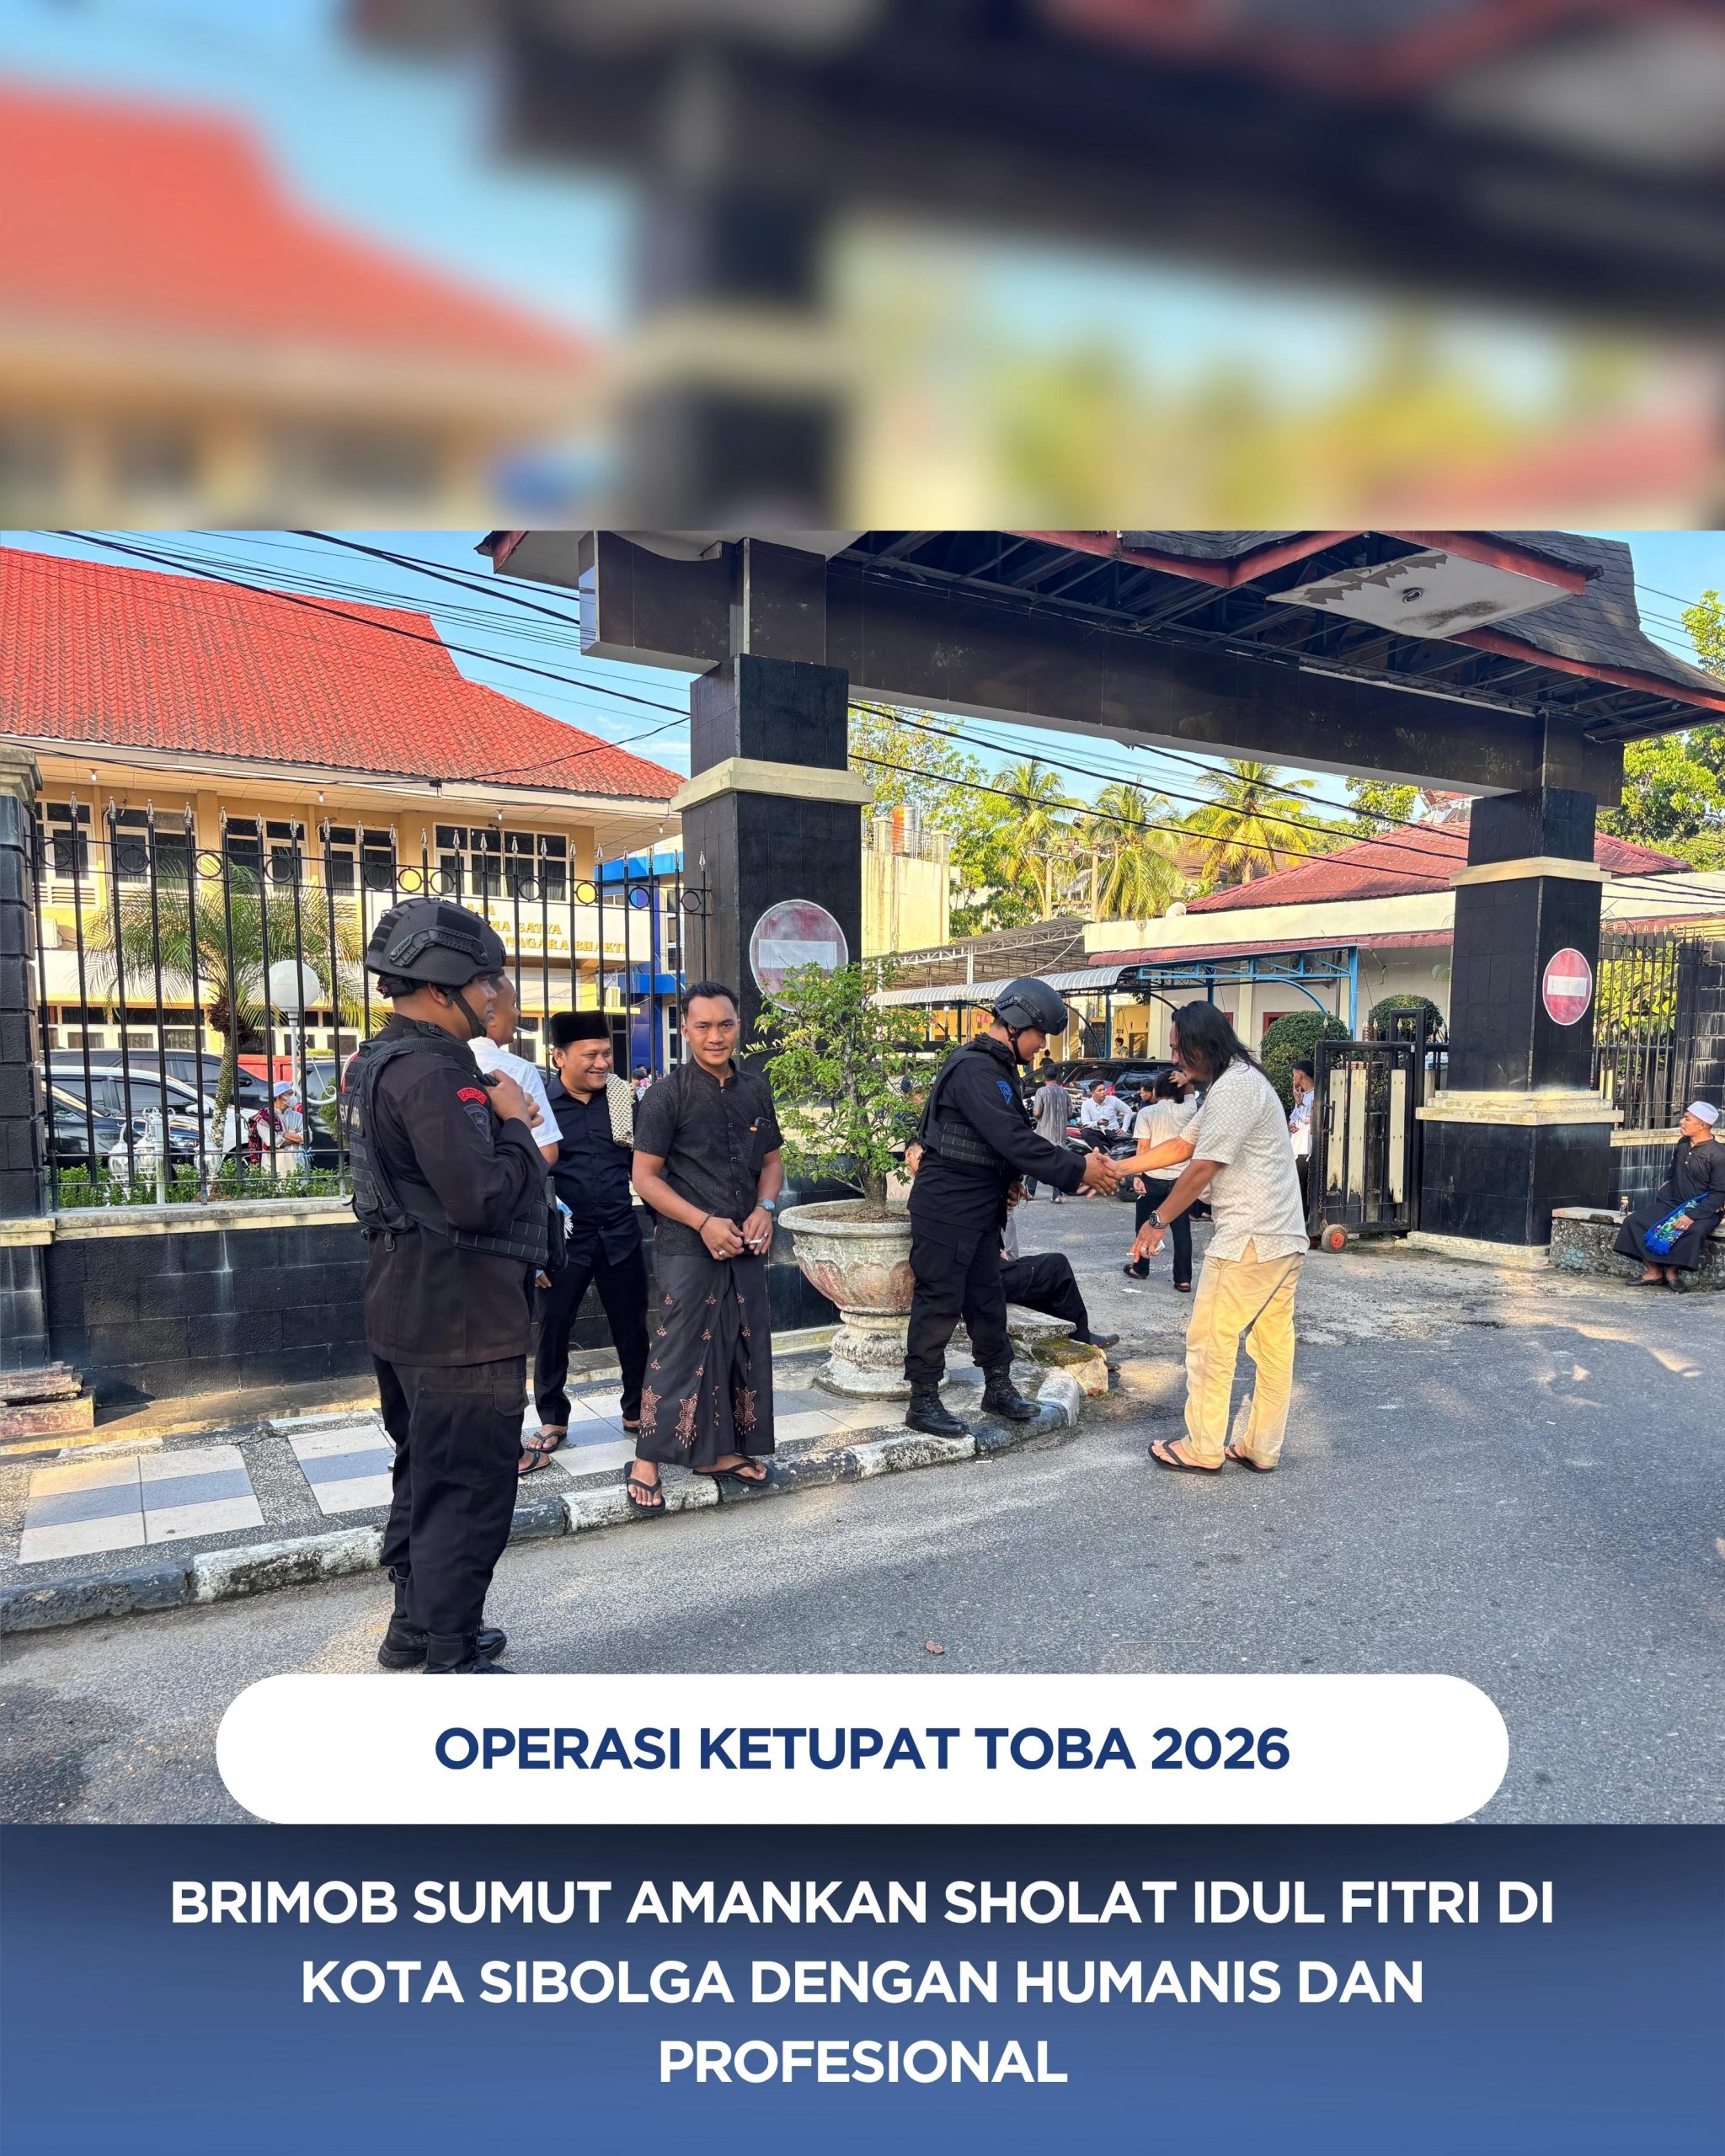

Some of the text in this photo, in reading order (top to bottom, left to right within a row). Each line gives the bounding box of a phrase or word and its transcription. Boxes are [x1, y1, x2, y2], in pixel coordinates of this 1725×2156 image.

[519, 922, 562, 935] SATYA
[505, 937, 626, 953] NAGARA BHAKTI
